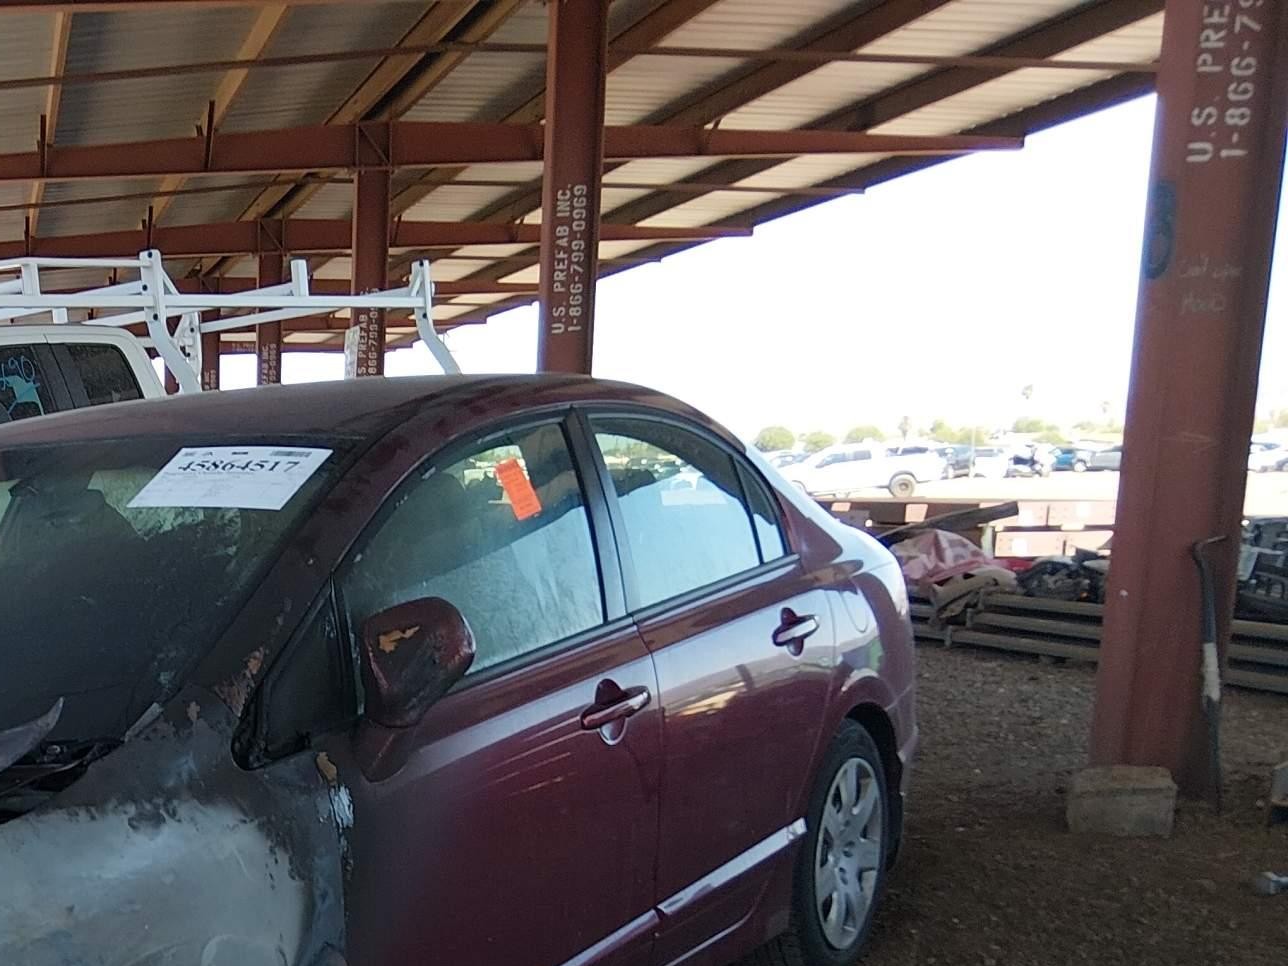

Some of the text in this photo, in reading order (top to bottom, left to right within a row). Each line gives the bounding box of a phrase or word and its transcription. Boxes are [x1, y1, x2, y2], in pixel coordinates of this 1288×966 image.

[1186, 97, 1220, 162] U.S.
[552, 183, 572, 334] U.S. PREFAB INC.
[568, 184, 588, 332] 1-866-799-0969
[177, 459, 300, 473] 45864517
